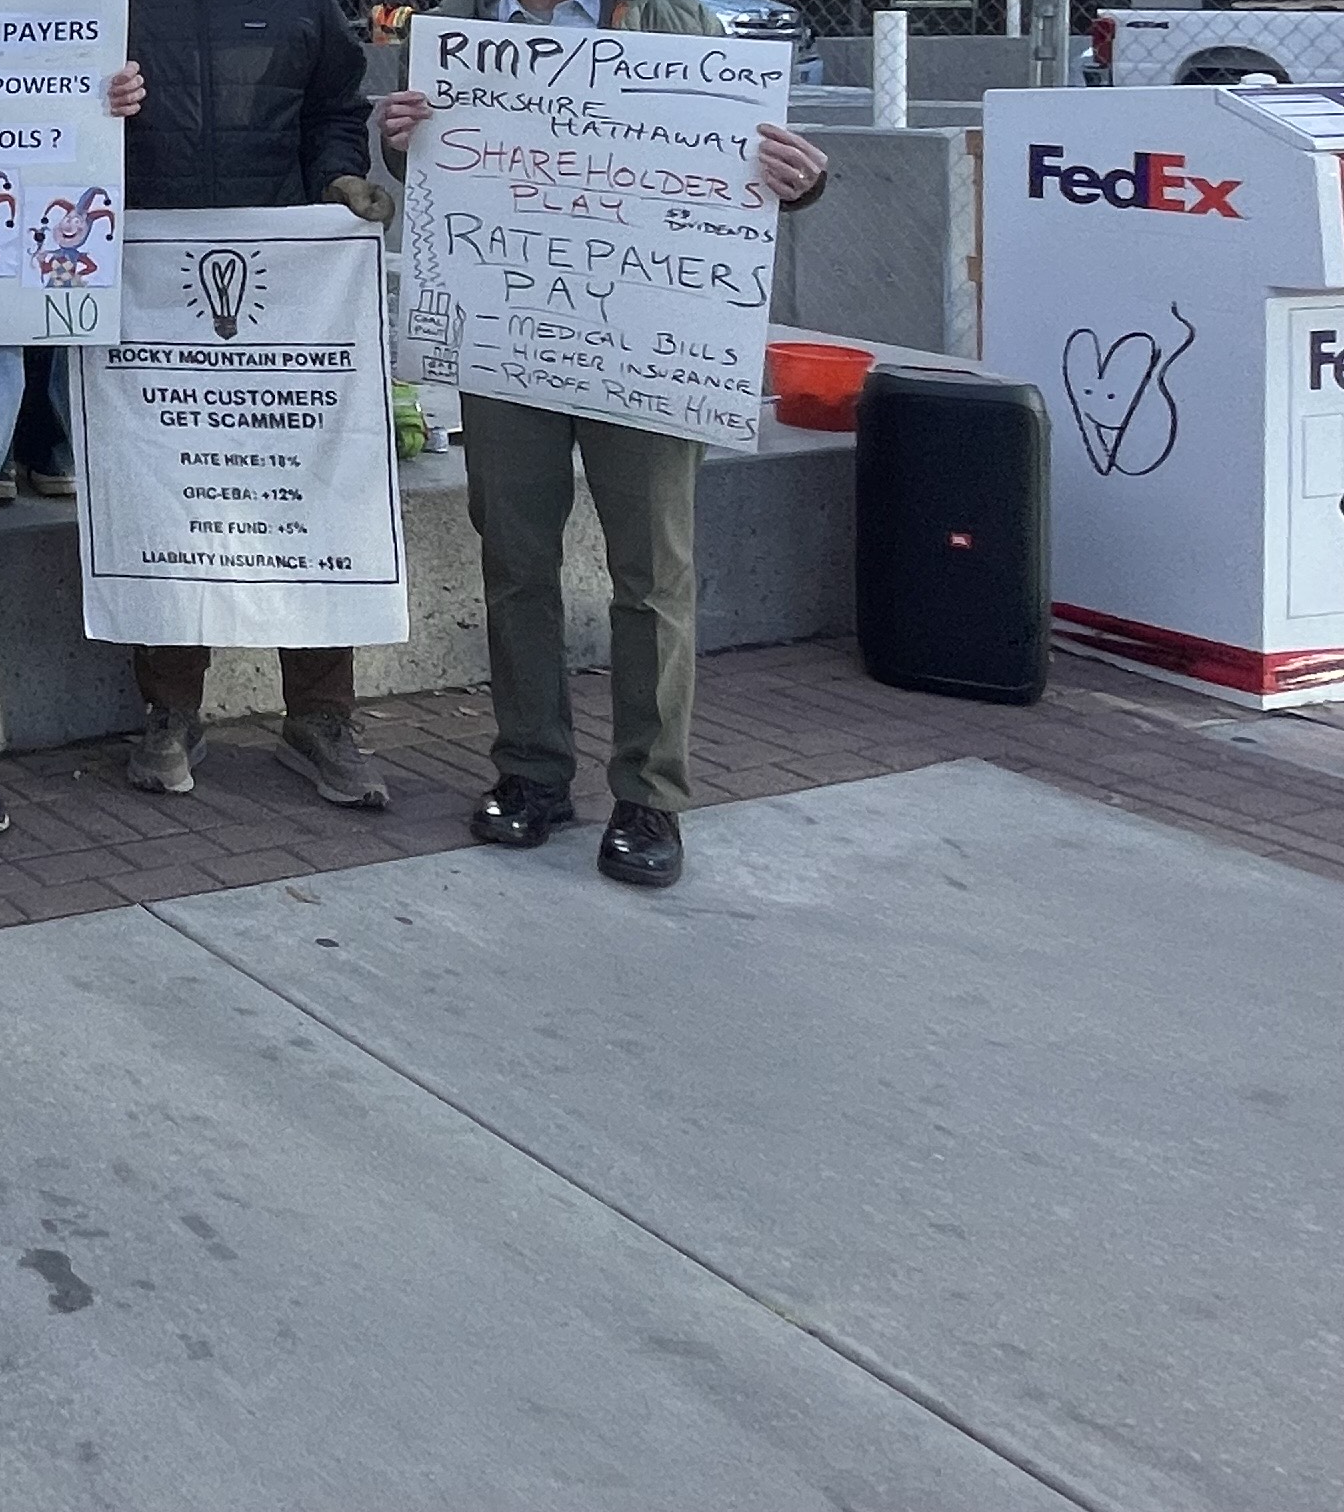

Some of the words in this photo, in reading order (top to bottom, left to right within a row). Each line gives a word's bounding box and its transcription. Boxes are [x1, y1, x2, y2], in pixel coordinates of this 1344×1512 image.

[426, 79, 611, 119] BERKSHIRE
[550, 117, 750, 160] HATHAWAY
[435, 127, 766, 210] SHAREHOLDERS
[1028, 143, 1248, 220] FedEx
[511, 184, 630, 225] PLAY
[443, 213, 767, 307] RATEPAYERS
[503, 270, 616, 322] PAY
[108, 348, 174, 364] ROCKY
[178, 350, 277, 367] MOUNTAIN
[282, 350, 352, 367] POWER
[508, 316, 633, 352] MEDICAL
[656, 332, 739, 366] BILLS
[513, 345, 605, 371] HIGHER
[620, 362, 760, 396] INSURANCE
[142, 387, 198, 405] UTAH
[204, 389, 339, 407] CUSTOMERS
[501, 363, 591, 393] RIPOFF
[605, 379, 673, 416] RATE
[684, 396, 759, 441] HIKES
[160, 410, 201, 427] GET
[207, 412, 324, 430] SCAMMED!
[180, 452, 221, 467] RATE
[224, 453, 266, 467] HIKE:
[261, 488, 303, 501] +12%
[189, 520, 224, 534] FIRE
[228, 521, 272, 535] FUND:
[142, 550, 216, 566] LIABILITY
